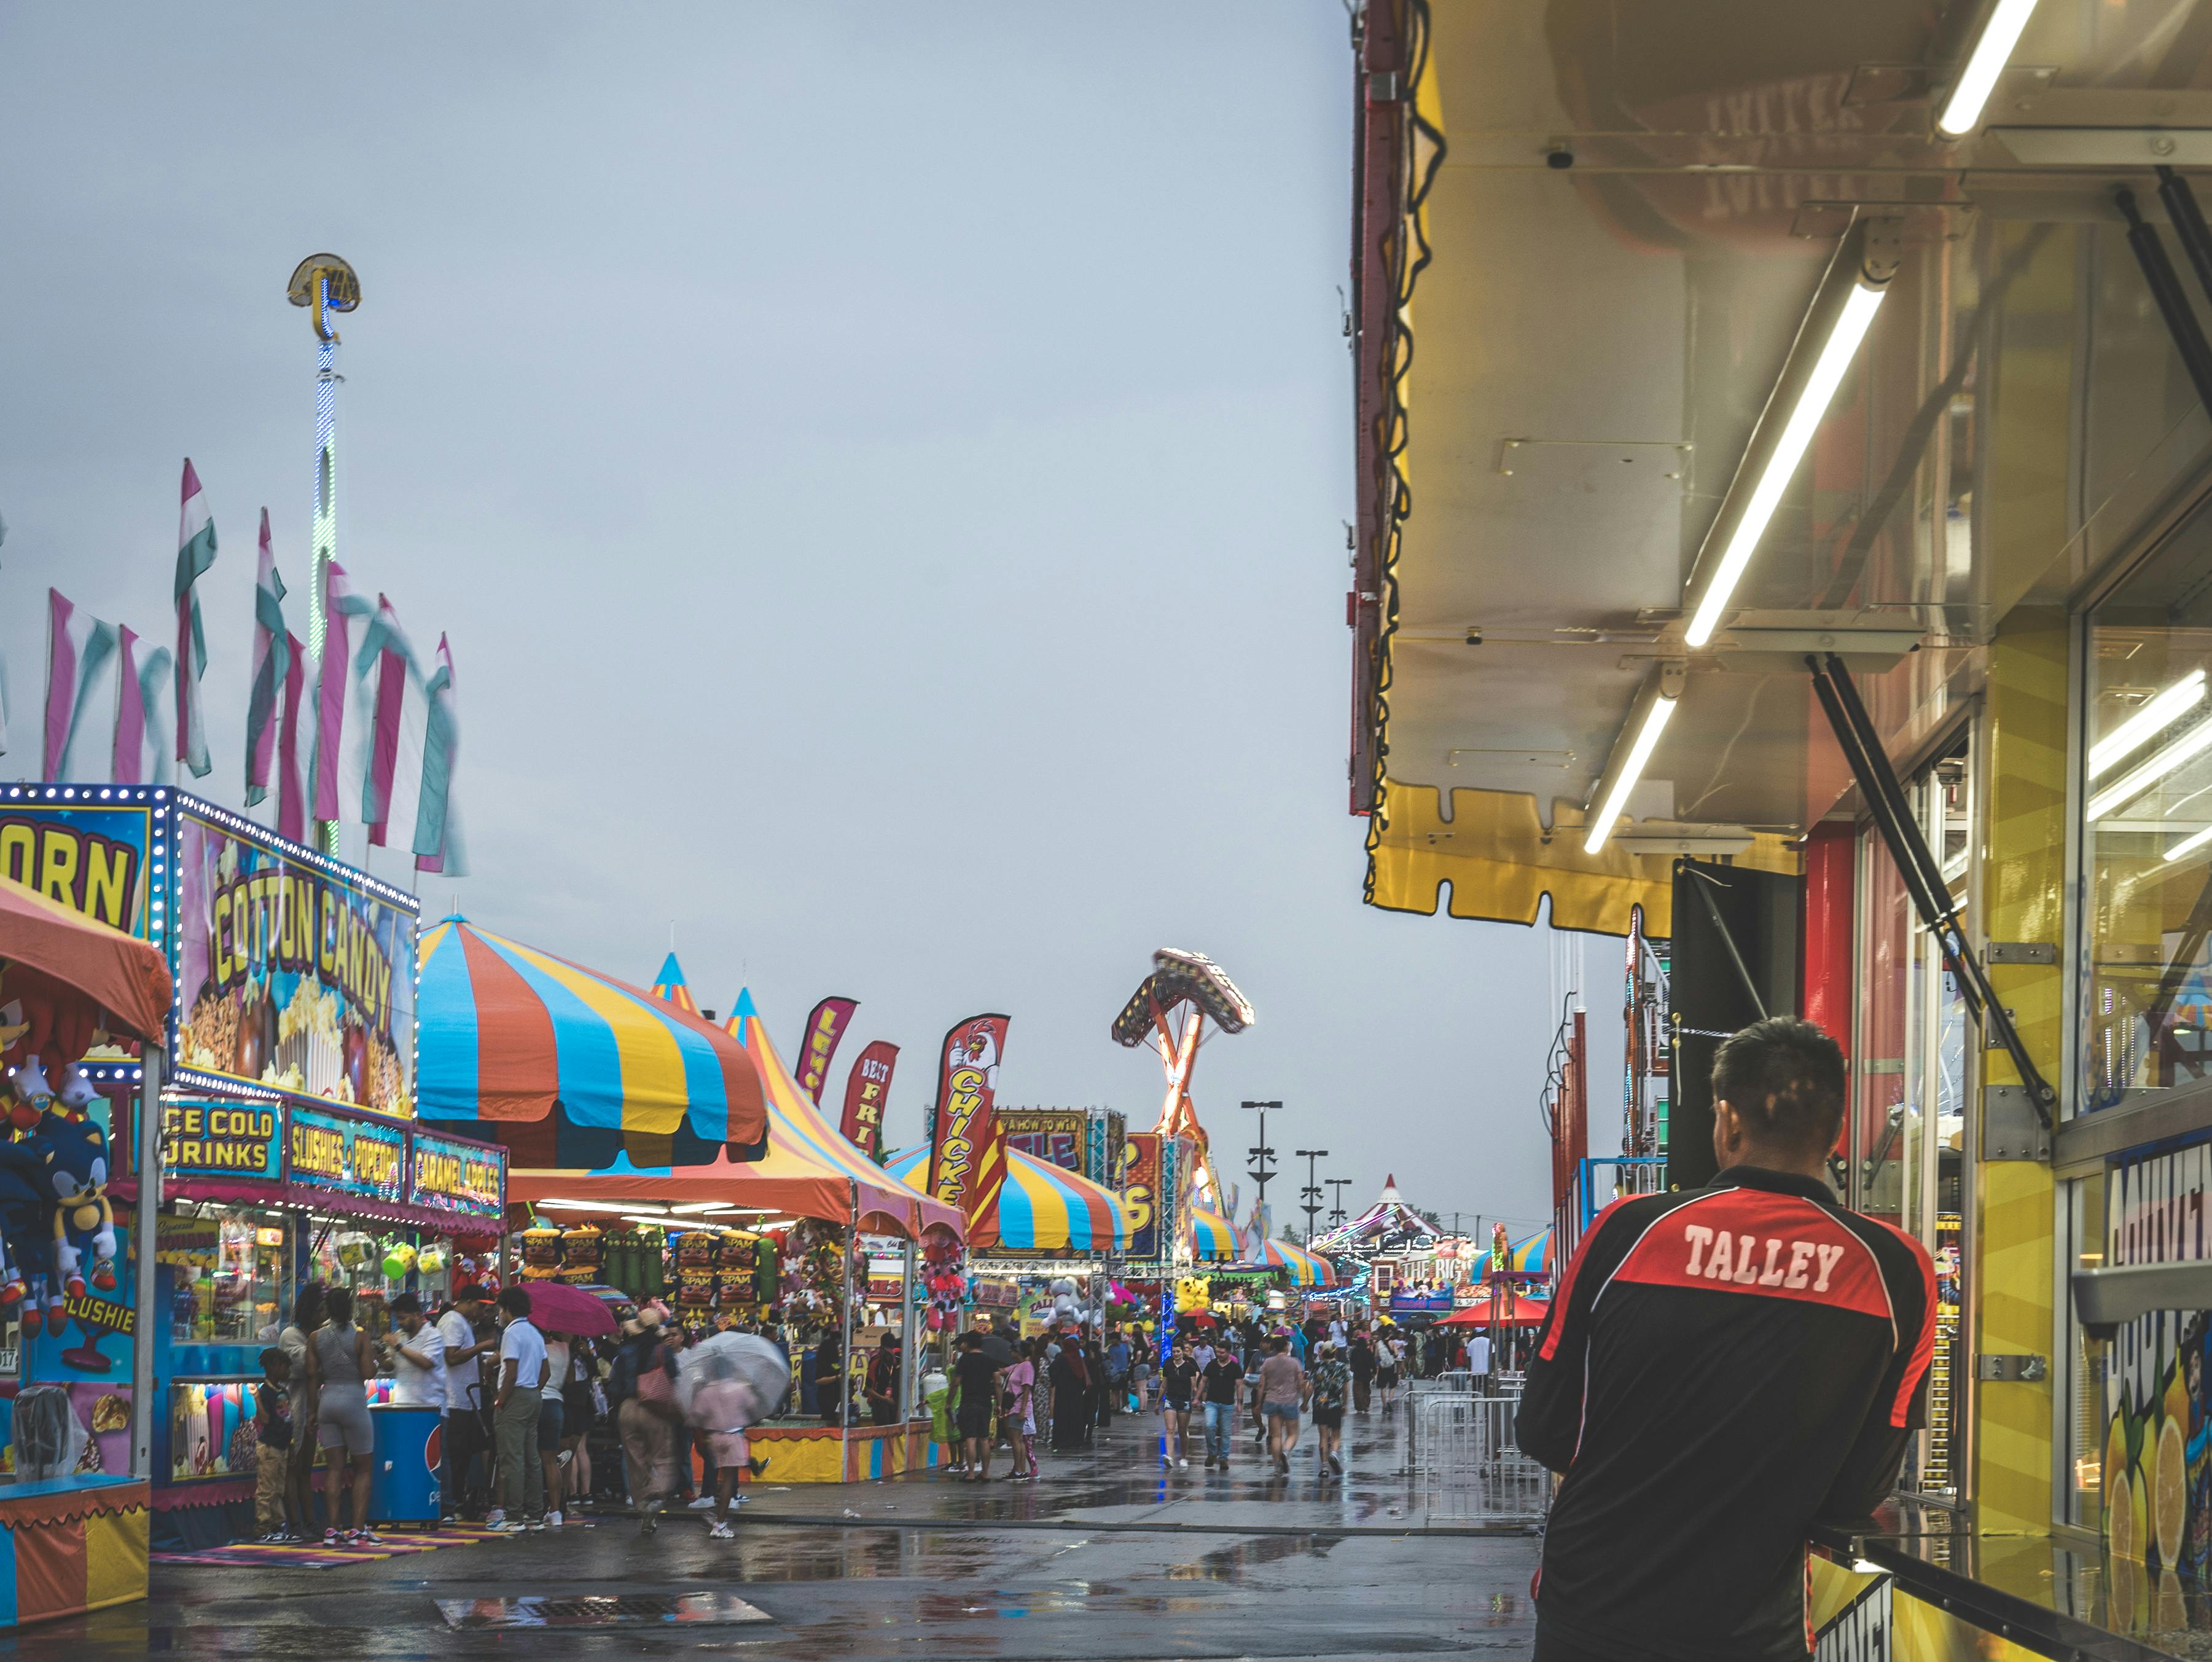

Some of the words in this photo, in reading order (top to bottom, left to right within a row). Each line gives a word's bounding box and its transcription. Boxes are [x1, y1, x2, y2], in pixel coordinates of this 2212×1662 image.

[216, 874, 314, 986] COTTON
[320, 888, 391, 1034] CANDY
[861, 1059, 889, 1083] BEST
[165, 1108, 203, 1133] CE
[210, 1110, 273, 1137] COLD
[1017, 1118, 1039, 1131] HOW
[1042, 1119, 1054, 1131] TO
[937, 1067, 984, 1207] CHICKE
[164, 1140, 267, 1168] DRINKS
[292, 1124, 345, 1176] SLUSHIES
[353, 1137, 400, 1183] POPCORN
[415, 1150, 461, 1196] CARAMEL
[464, 1161, 500, 1204] APPLES
[525, 1236, 554, 1247] SPAM
[565, 1237, 596, 1248] SPAM
[679, 1239, 709, 1248] SPAM
[724, 1237, 754, 1249] SPAM
[1684, 1224, 1845, 1293] TALLEY
[565, 1273, 595, 1284] SPAM
[1401, 1260, 1429, 1279] THE
[681, 1276, 712, 1286] SPAM
[721, 1274, 751, 1285] SPAM
